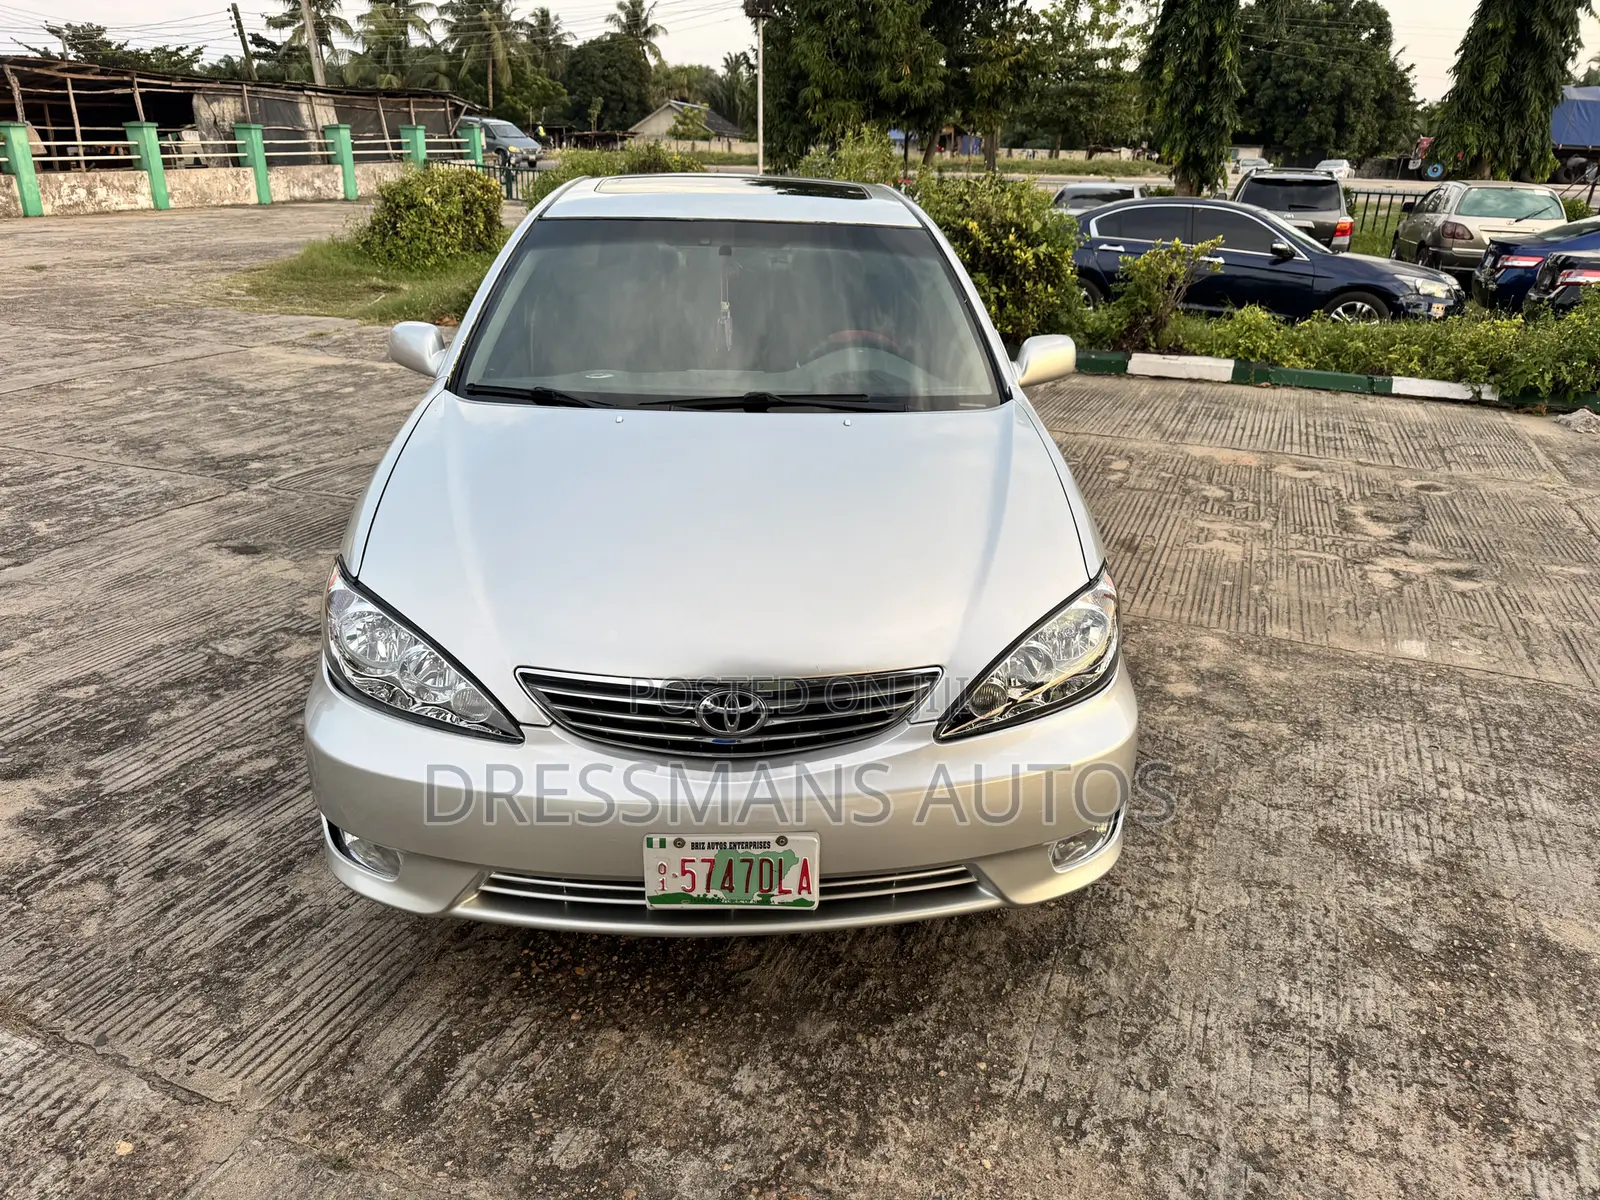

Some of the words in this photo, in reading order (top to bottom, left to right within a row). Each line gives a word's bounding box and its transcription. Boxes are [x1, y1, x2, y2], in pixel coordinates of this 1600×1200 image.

[691, 842, 705, 850] BRIZ
[707, 842, 727, 850] AUTOS
[729, 841, 771, 850] ENTERPRISES
